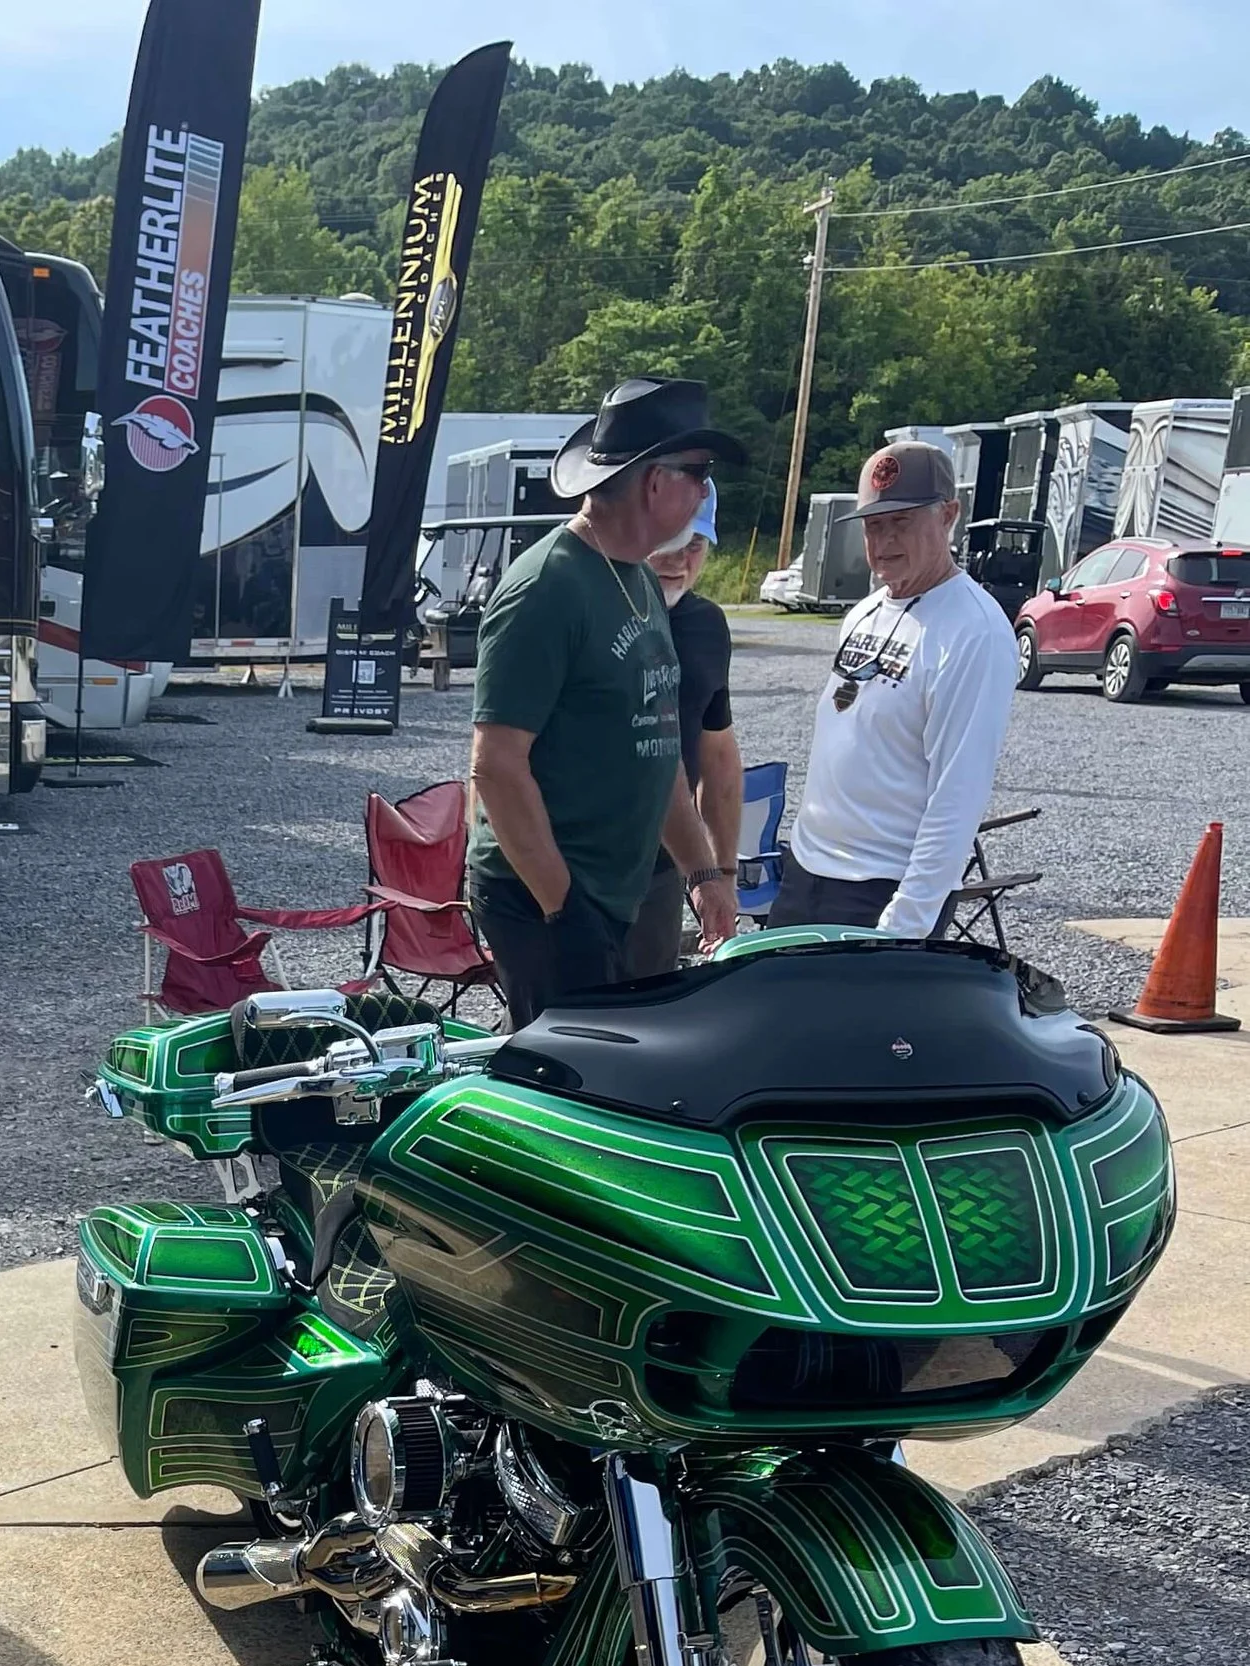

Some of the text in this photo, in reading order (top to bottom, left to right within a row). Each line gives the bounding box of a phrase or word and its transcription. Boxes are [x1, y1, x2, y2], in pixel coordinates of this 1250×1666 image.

[125, 124, 187, 389] FEATHERLITE
[170, 268, 205, 390] COACHES
[380, 173, 434, 444] MILLENNIUM
